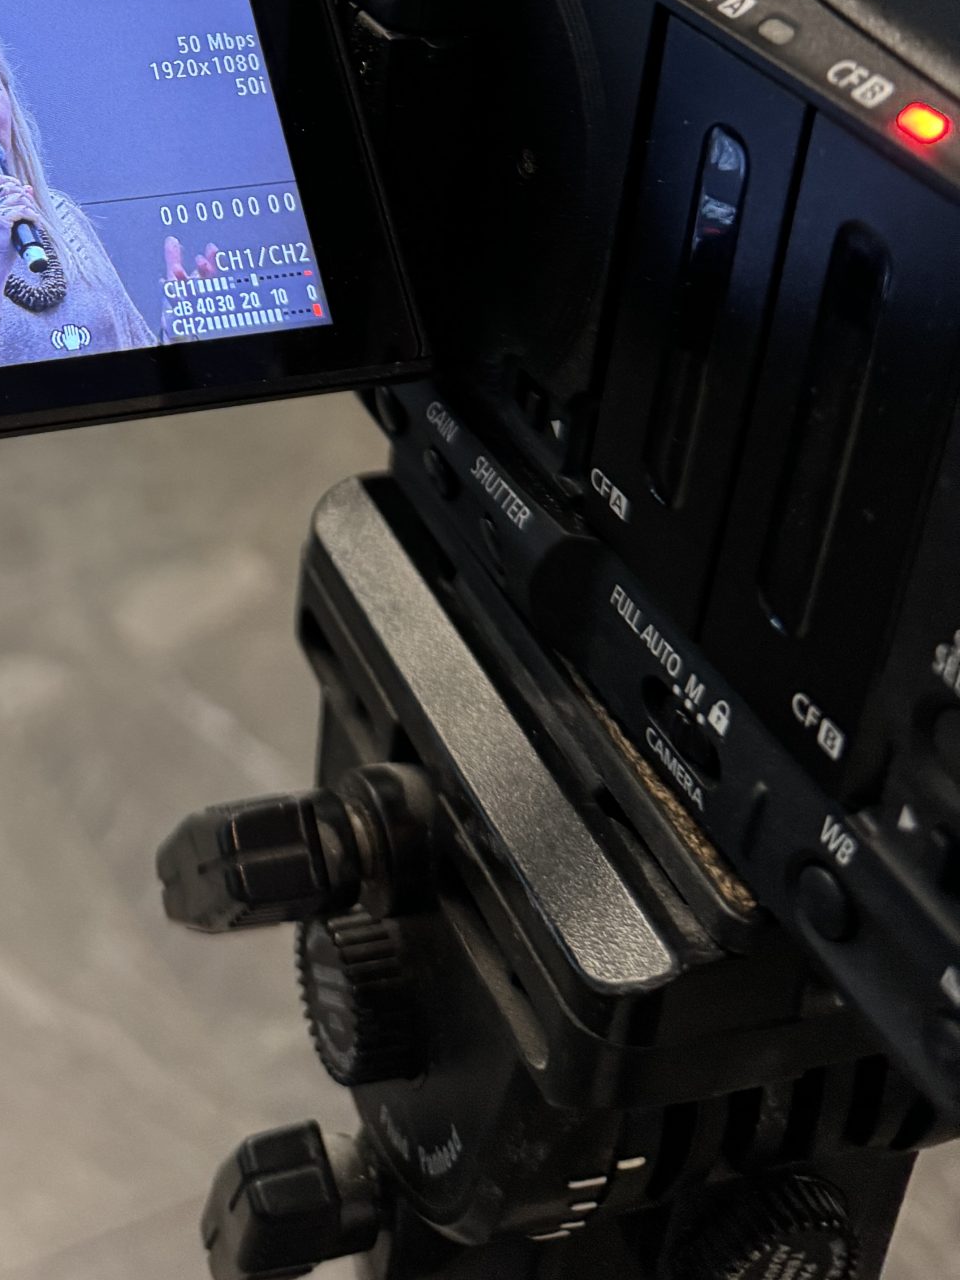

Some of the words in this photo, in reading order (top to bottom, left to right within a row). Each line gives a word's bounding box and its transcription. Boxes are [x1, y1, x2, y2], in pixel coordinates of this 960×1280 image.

[177, 35, 200, 54] 50
[206, 32, 256, 51] Mbps
[150, 53, 260, 80] 1920x1080
[235, 76, 267, 96] 50i
[215, 242, 310, 271] CH1/CH2
[164, 280, 197, 298] CH1
[196, 296, 215, 313] 40
[218, 294, 235, 311] 30
[240, 292, 260, 309] 20
[270, 288, 288, 304] 10
[306, 284, 318, 301] 0
[172, 318, 207, 336] CH2
[426, 401, 459, 443] GAIN
[470, 455, 531, 529] SHUTTER
[610, 584, 641, 634] FULL
[640, 624, 682, 677] AUTO
[684, 673, 706, 704] M
[645, 727, 704, 812] CAMERA
[820, 814, 859, 867] WB
